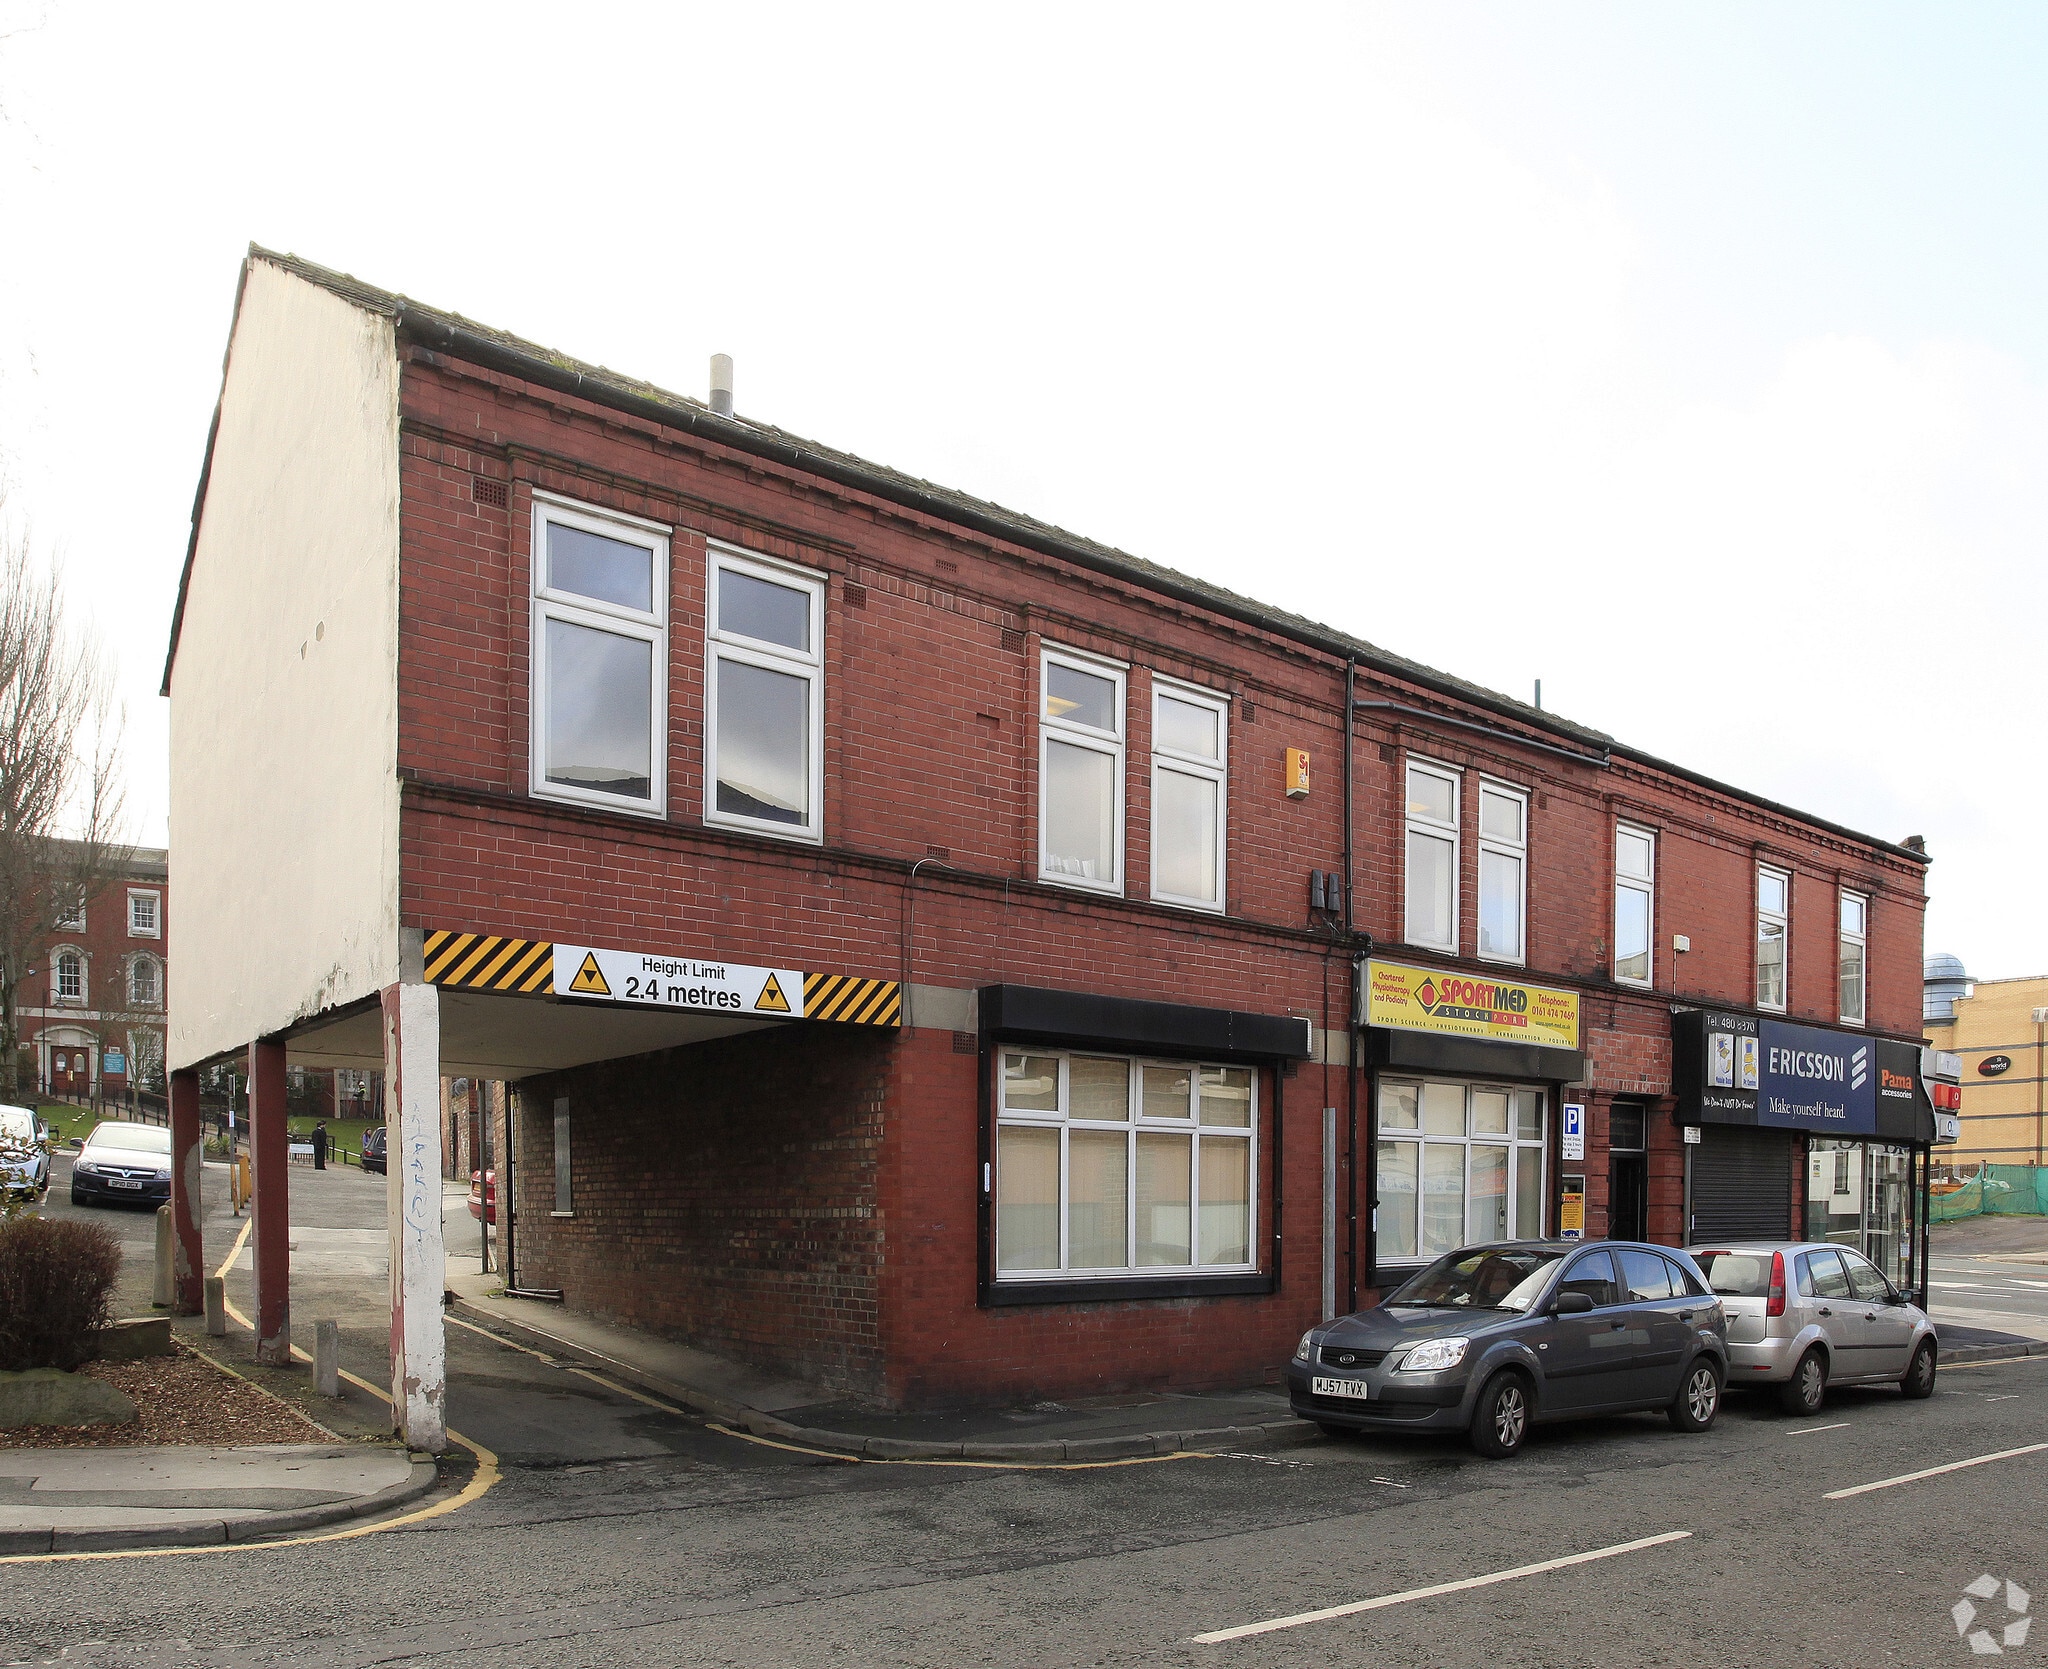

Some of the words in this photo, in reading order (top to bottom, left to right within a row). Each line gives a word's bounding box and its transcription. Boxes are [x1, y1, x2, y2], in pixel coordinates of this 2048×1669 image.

[641, 957, 688, 977] Height
[692, 963, 726, 980] Limit
[1378, 971, 1405, 983] Chartered
[625, 976, 660, 1000] 2.4
[667, 985, 742, 1009] metres
[1372, 981, 1411, 997] Physiotherapy
[1440, 978, 1528, 1013] SPORTMED
[1374, 994, 1385, 1002] and
[1385, 995, 1408, 1007] Podiatry
[1538, 994, 1570, 1007] Telephone:
[1445, 1007, 1526, 1025] STOCKPORT
[1531, 1005, 1546, 1017] 0161
[1546, 1008, 1559, 1018] 474
[1377, 1016, 1397, 1024] SPORT
[1401, 1019, 1426, 1027] SCIENCE
[1436, 1024, 1484, 1034] PHYSIOTHERAPY
[1496, 1031, 1540, 1041] REHABILITATION
[1721, 1017, 1736, 1029] 480
[1769, 1046, 1844, 1082] ERICSSON
[1881, 1069, 1913, 1090] Pama
[1881, 1088, 1913, 1100] accessories
[1769, 1096, 1791, 1114] Make
[1792, 1101, 1823, 1119] yourself
[1824, 1102, 1846, 1119] heard.
[1567, 1109, 1578, 1133] P
[1316, 1378, 1341, 1393] MJ57
[1343, 1381, 1363, 1396] TVX
